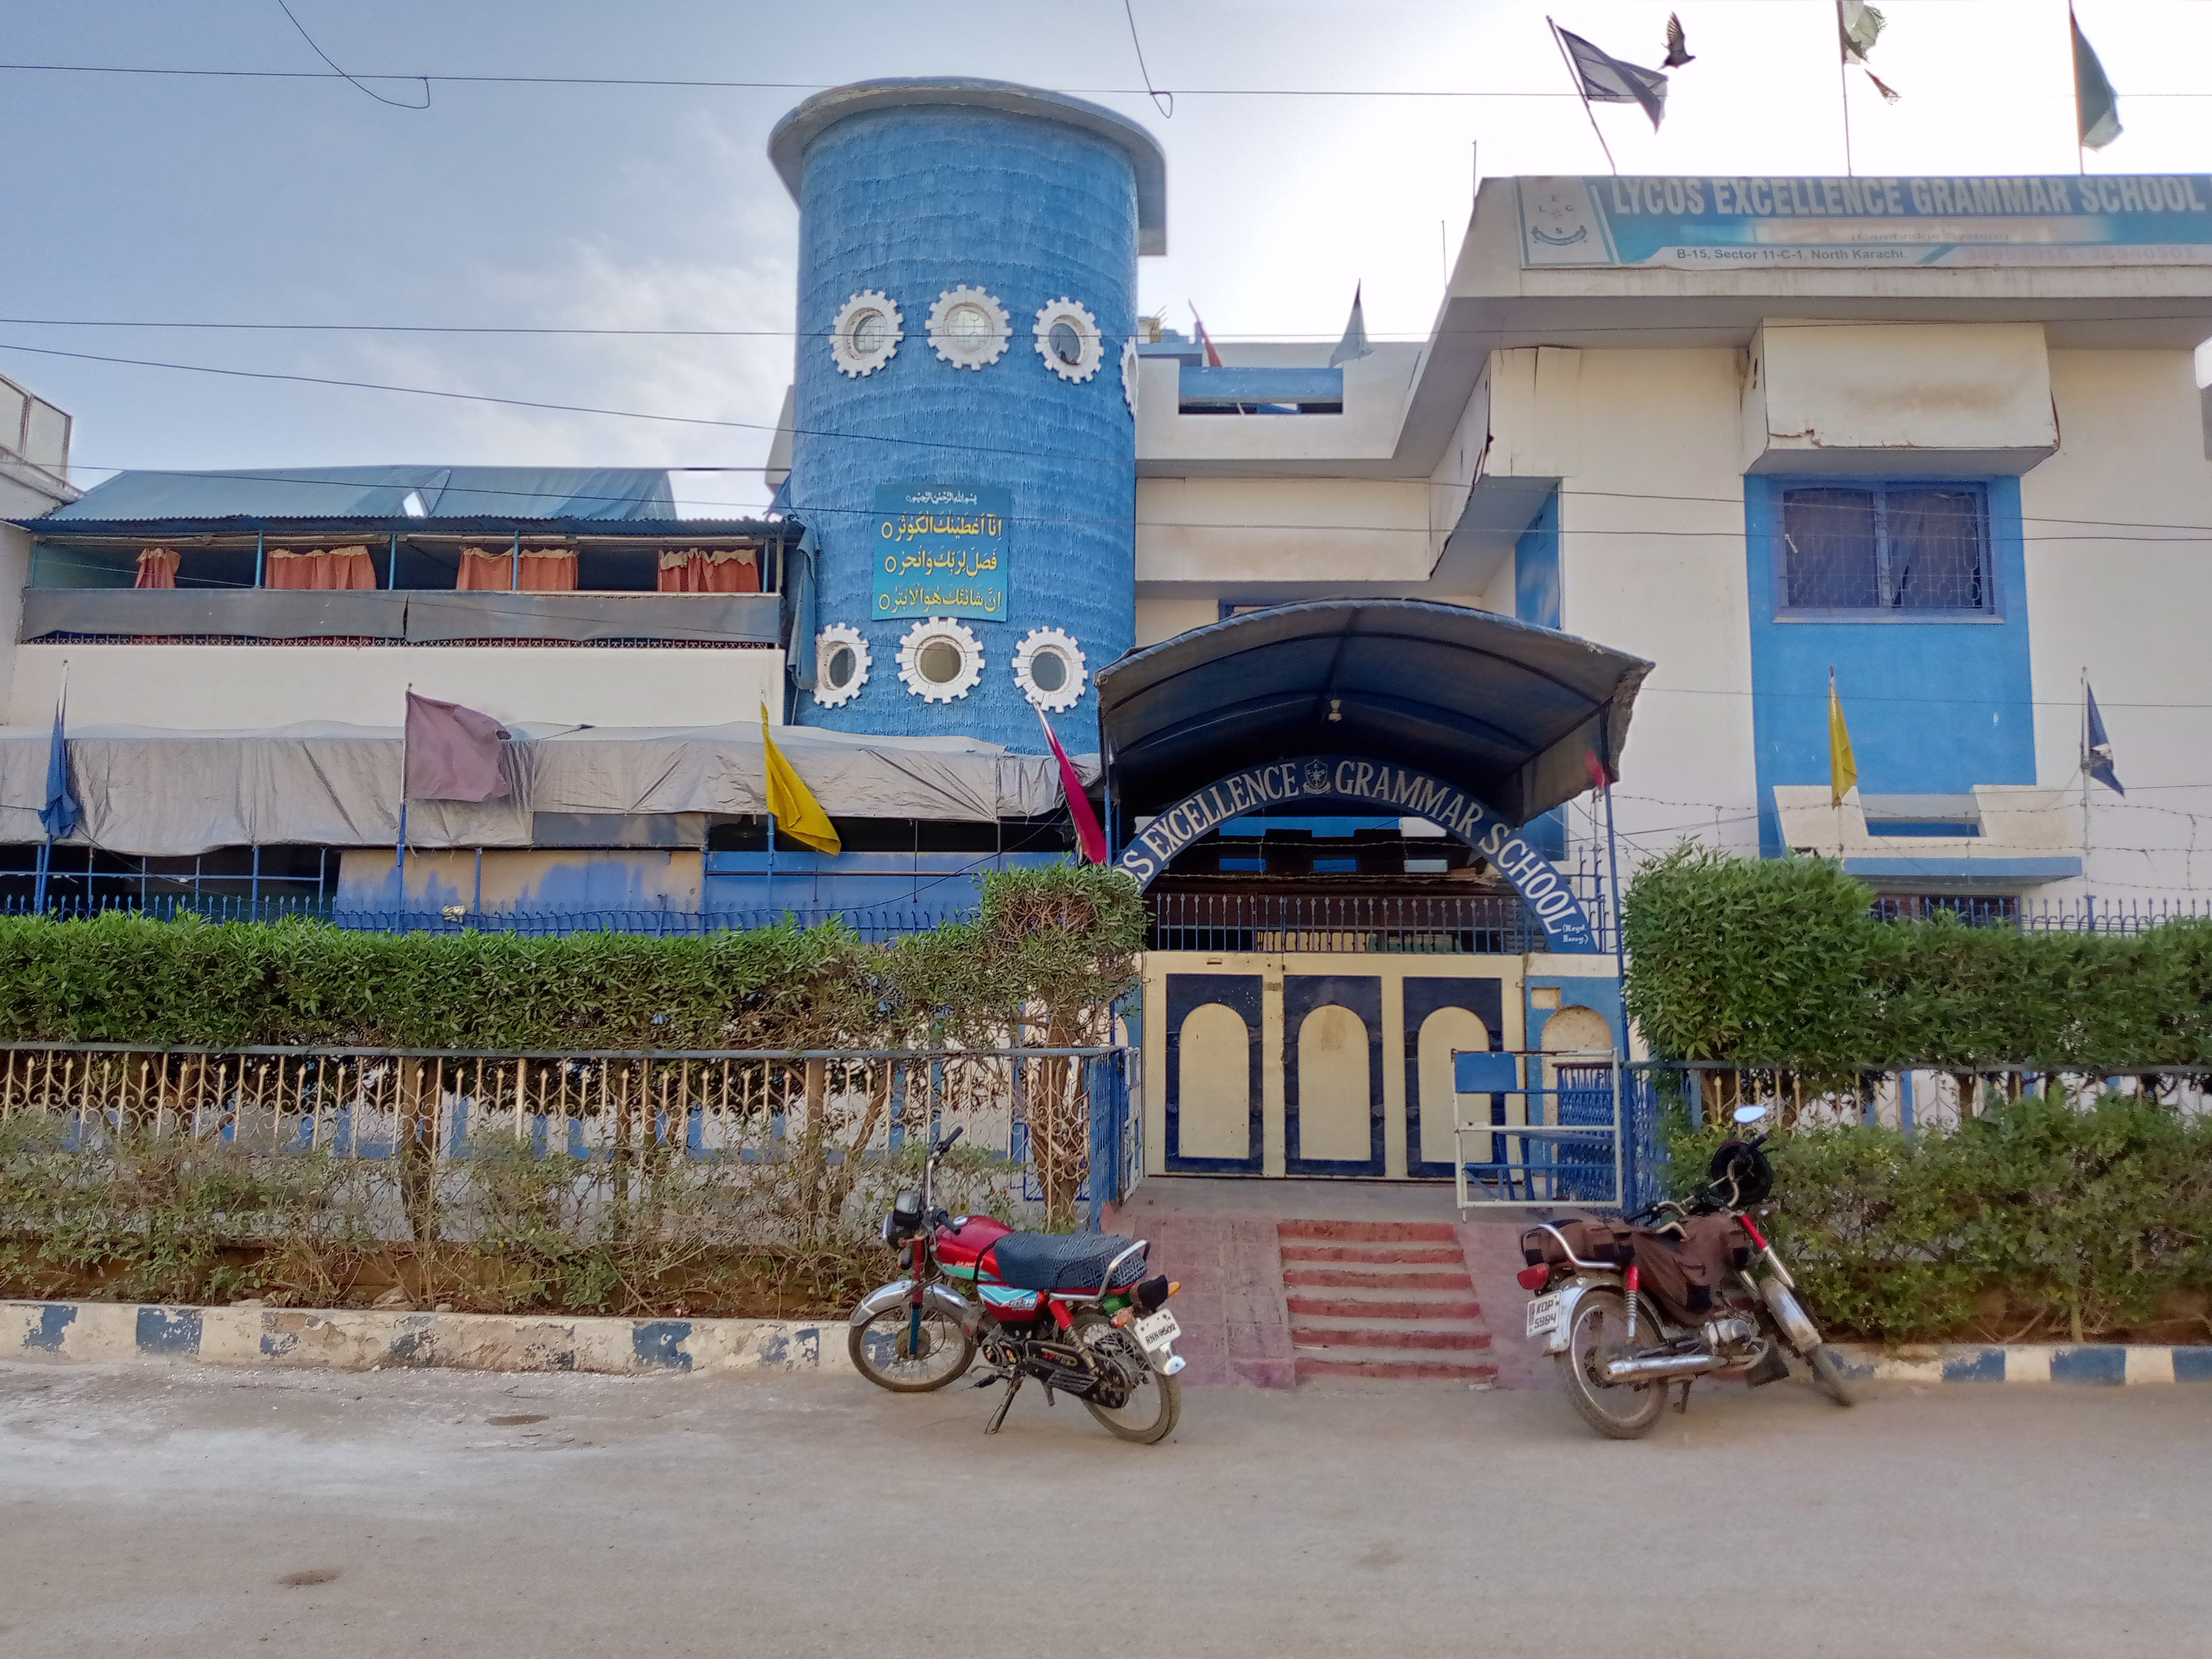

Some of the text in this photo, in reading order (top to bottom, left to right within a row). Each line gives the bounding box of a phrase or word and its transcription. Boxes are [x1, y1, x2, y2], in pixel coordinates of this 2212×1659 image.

[1611, 176, 2206, 214] LYCOS EXCELLENCE GRAMMAR SCHOOL
[1677, 248, 1711, 260] B-15,
[1714, 248, 1758, 259] Sector
[1811, 249, 1849, 259] North
[1852, 249, 1907, 259] Karachi.
[1139, 763, 1300, 862] EXCELLENCE
[1335, 760, 1484, 838] GRAMMAR
[1478, 823, 1577, 934] SCHOOL
[1535, 1312, 1556, 1329] 5984
